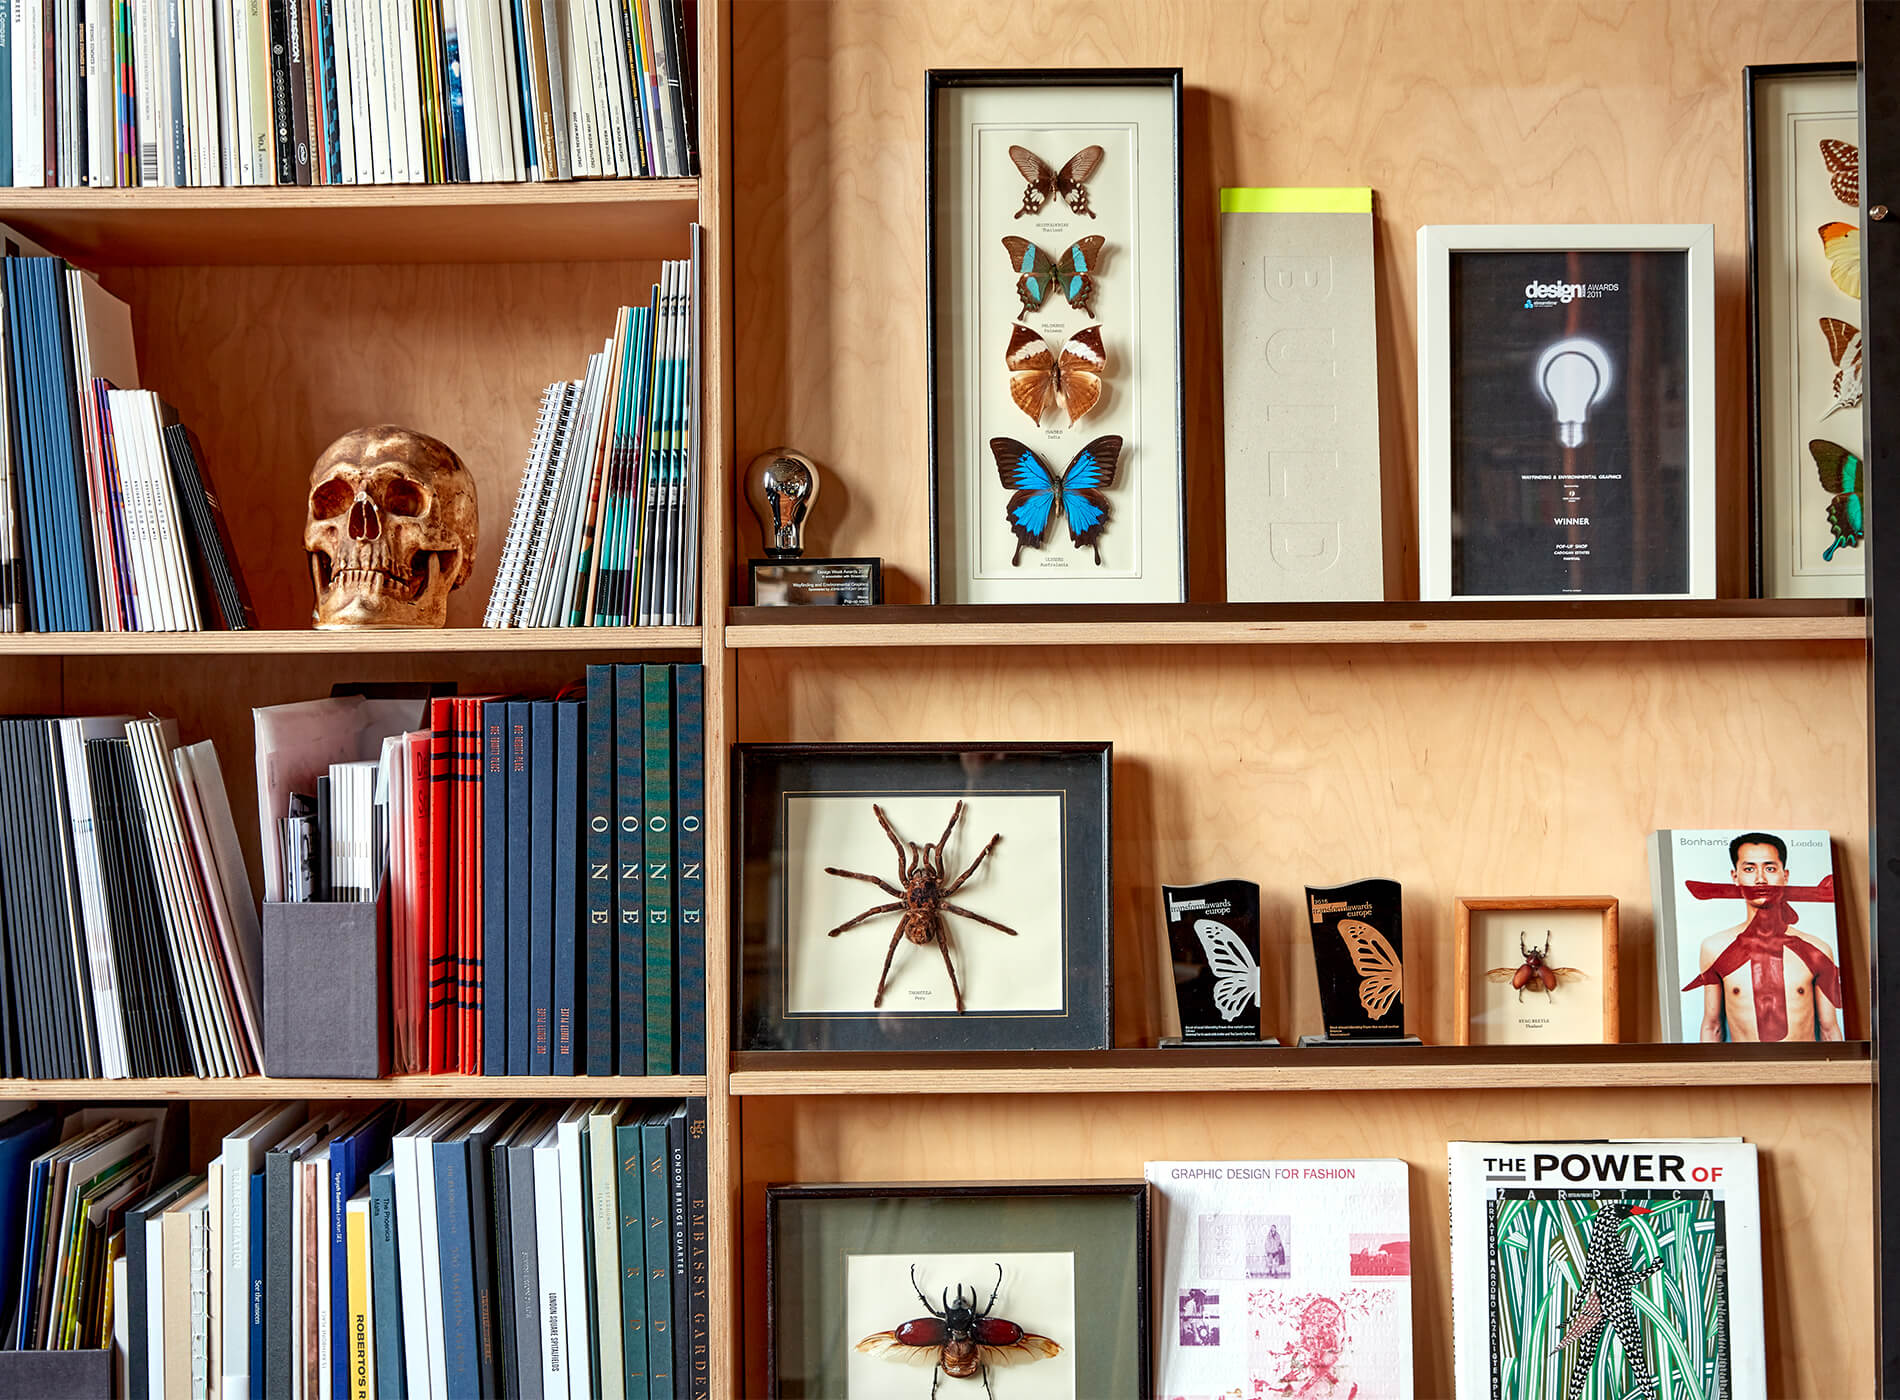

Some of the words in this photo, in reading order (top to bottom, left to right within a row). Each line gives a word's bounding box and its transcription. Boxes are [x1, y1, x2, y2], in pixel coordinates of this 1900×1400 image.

[1525, 280, 1582, 303] design
[1587, 284, 1620, 292] AWARDS
[1263, 255, 1340, 573] BUILD
[1680, 837, 1728, 846] Bonhams
[1790, 839, 1824, 848] London
[591, 816, 608, 924] ONE
[622, 816, 639, 924] ONE
[650, 816, 666, 924] ONE
[682, 816, 700, 924] ONE
[1205, 906, 1231, 916] europe
[1171, 1168, 1223, 1180] GRAPHIC
[1226, 1168, 1271, 1180] DESIGN
[1274, 1168, 1300, 1179] FOR
[1303, 1168, 1356, 1179] FASHION
[1484, 1158, 1526, 1172] THE
[1534, 1154, 1686, 1182] POWER
[1692, 1168, 1723, 1182] OF
[232, 1168, 242, 1268] TRANSFORMATION
[692, 1200, 705, 1300] EMBASSY
[549, 1293, 557, 1314] LONDON
[550, 1316, 558, 1336] SQUARE
[356, 1314, 366, 1387] ROBERTO'S
[550, 1338, 559, 1372] SPITALFIELDS
